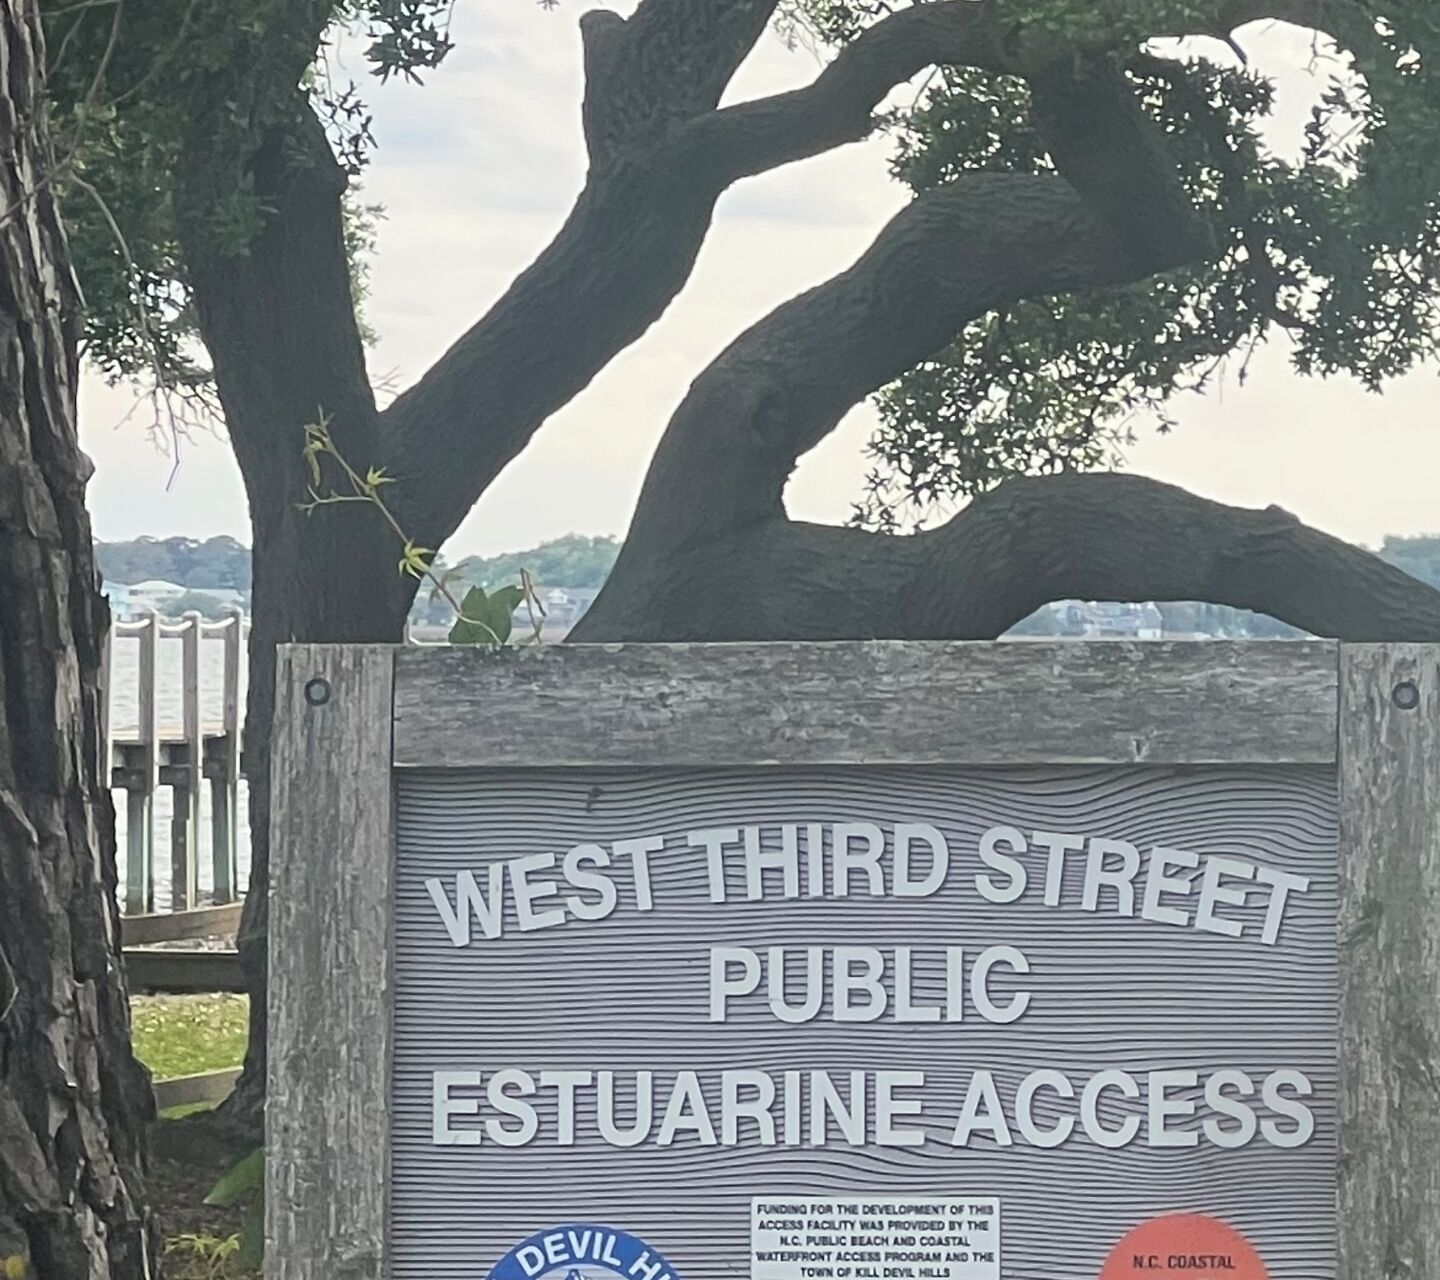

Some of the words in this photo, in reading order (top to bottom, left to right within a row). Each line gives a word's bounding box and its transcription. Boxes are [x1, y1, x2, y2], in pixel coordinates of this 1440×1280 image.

[424, 835, 663, 947] WEST
[686, 822, 951, 904] THIRD
[973, 825, 1311, 946] STREET
[708, 945, 1032, 1025] PUBLIC
[430, 1069, 926, 1147] ESTUARINE
[951, 1069, 1315, 1149] ACCESS
[756, 1204, 808, 1215] FUNDING
[810, 1204, 834, 1215] FOR
[837, 1204, 859, 1215] THE
[862, 1204, 946, 1215] DEVELOPMENT
[950, 1204, 965, 1215] OF
[968, 1204, 994, 1215] THIS
[758, 1220, 804, 1231] ACCESS
[807, 1220, 856, 1231] FACILITY
[860, 1220, 884, 1231] WAS
[888, 1220, 945, 1231] PROVIDED
[949, 1220, 963, 1231] BY
[967, 1220, 989, 1231] THE
[780, 1236, 802, 1247] N.C.
[806, 1236, 847, 1247] PUBLIC
[851, 1236, 889, 1247] BEACH
[893, 1236, 916, 1247] AND
[919, 1236, 971, 1247] COASTAL
[515, 1230, 621, 1277] DEVIL
[755, 1251, 832, 1262] WATERFRONT
[836, 1251, 881, 1262] ACCESS
[884, 1251, 942, 1262] PROGRAM
[945, 1251, 969, 1262] AND
[972, 1251, 994, 1262] THE
[1133, 1255, 1163, 1269] N.C.
[1167, 1255, 1236, 1269] COASTAL
[800, 1267, 833, 1278] TOWN
[837, 1267, 852, 1278] OF
[855, 1267, 879, 1278] KILL
[883, 1267, 915, 1278] DEVIL
[919, 1267, 950, 1278] HILLS
